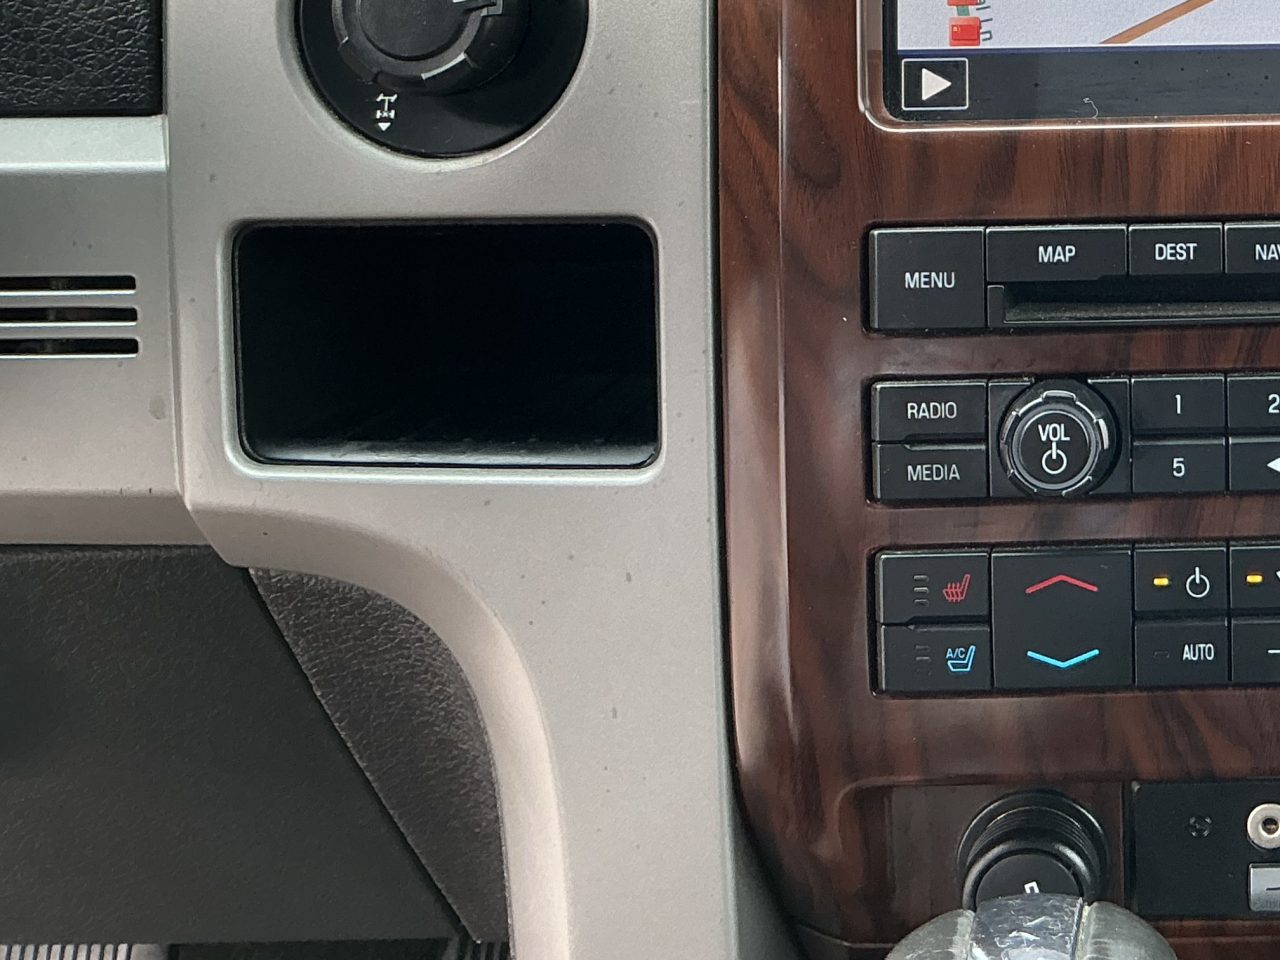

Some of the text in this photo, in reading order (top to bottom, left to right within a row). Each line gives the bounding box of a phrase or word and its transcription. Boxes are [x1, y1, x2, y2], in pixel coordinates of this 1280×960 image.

[1037, 245, 1076, 263] MAP
[1154, 243, 1197, 261] DEST
[904, 272, 956, 289] MENU
[906, 401, 958, 420] RADIO
[1174, 395, 1183, 415] 1
[1267, 394, 1280, 414] 2
[1037, 423, 1070, 442] VOL
[906, 464, 961, 482] MEDIA
[1172, 457, 1185, 478] 5
[946, 648, 966, 659] A/C
[1182, 644, 1215, 661] AUTO
